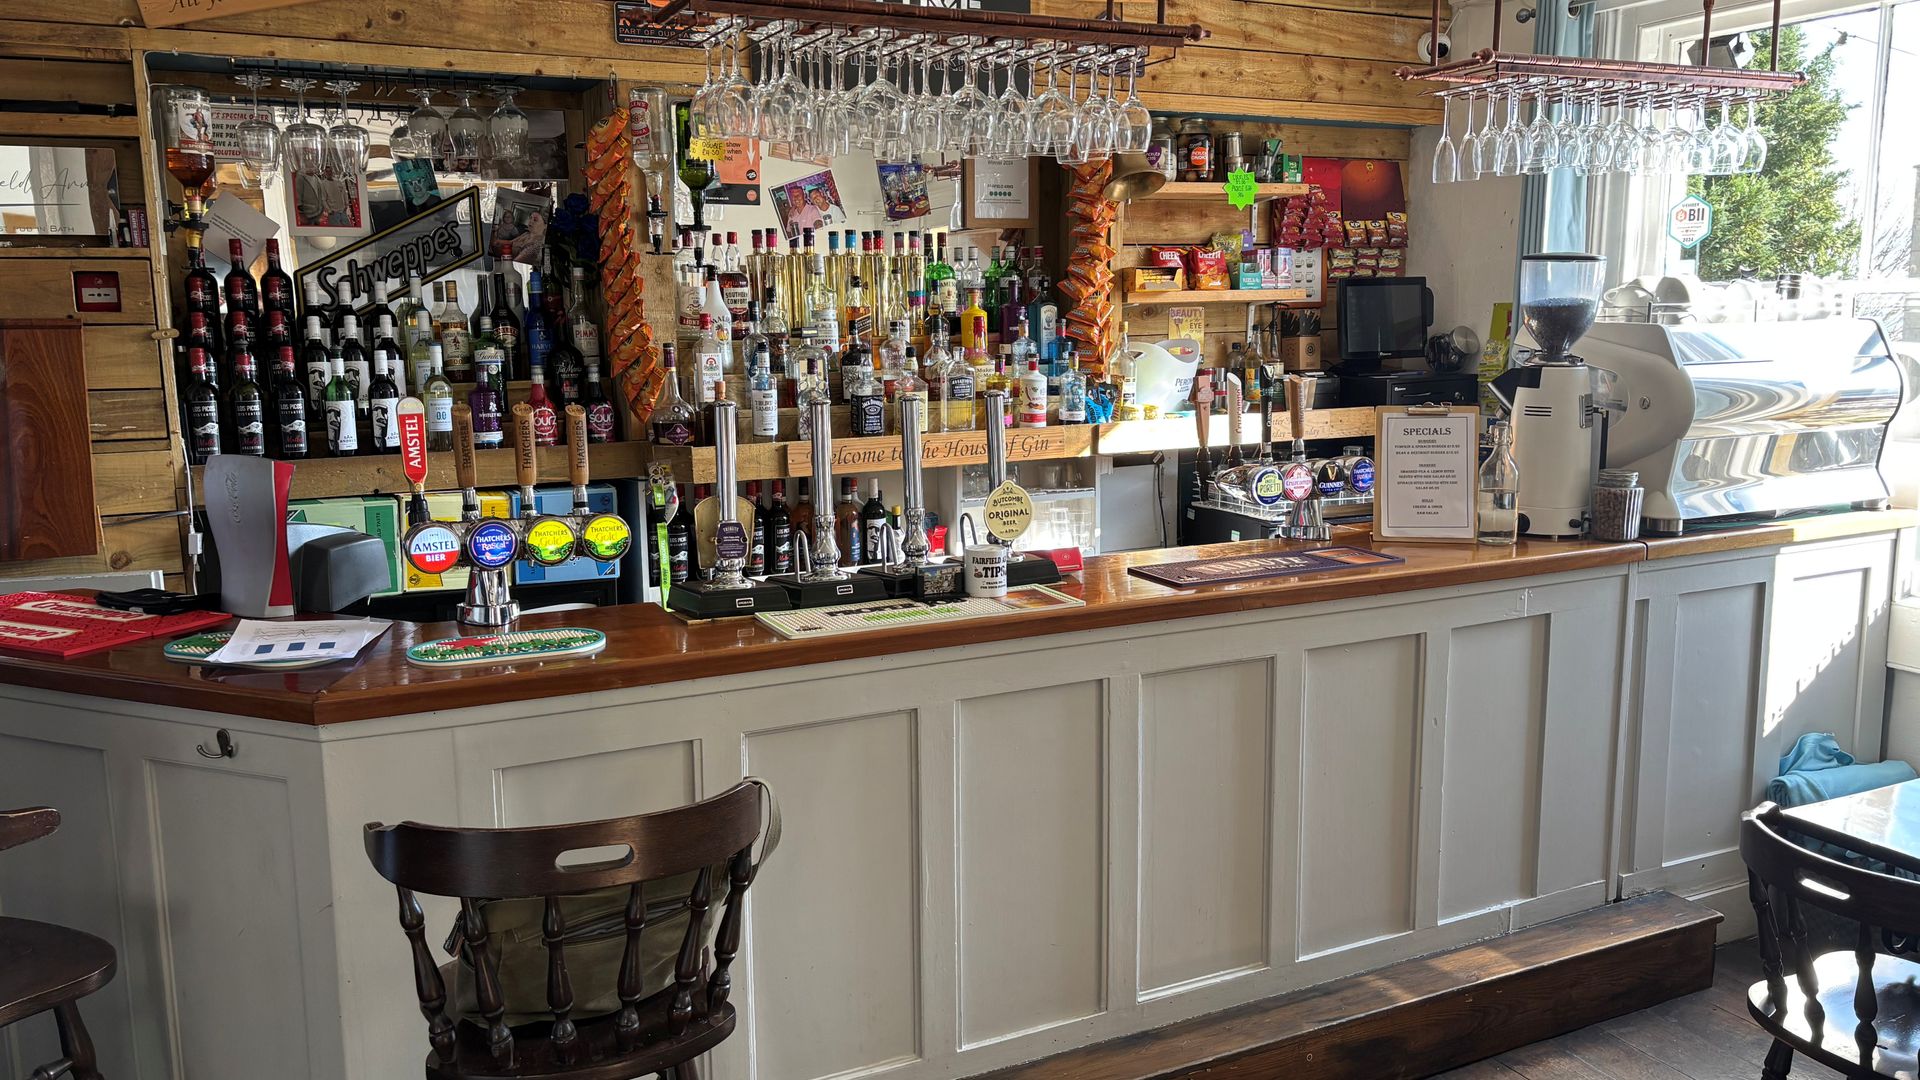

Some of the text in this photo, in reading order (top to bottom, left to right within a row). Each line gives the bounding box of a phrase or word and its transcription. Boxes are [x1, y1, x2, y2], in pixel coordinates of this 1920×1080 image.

[221, 112, 247, 120] SPECIAL
[1170, 309, 1202, 318] BEAUTY
[1403, 427, 1451, 436] SPECIALS
[409, 415, 423, 469] AMSTEL
[522, 419, 532, 471] THATCHERS
[576, 419, 585, 470] THATCHERS
[943, 438, 987, 458] Hous
[1021, 433, 1049, 453] Gin
[1259, 483, 1283, 493] PORETTI
[1318, 481, 1345, 489] GUINNESS
[993, 496, 1023, 506] BUTCOMBE
[989, 508, 1030, 521] ORIGINAL
[534, 529, 568, 538] THATCHERS
[590, 525, 624, 534] THATCHERS
[475, 533, 512, 544] THATCHERS
[413, 541, 457, 553] AMSTEL
[425, 553, 447, 562] BIER
[972, 556, 1001, 565] FAIRFIELD
[982, 566, 1007, 578] TIPS
